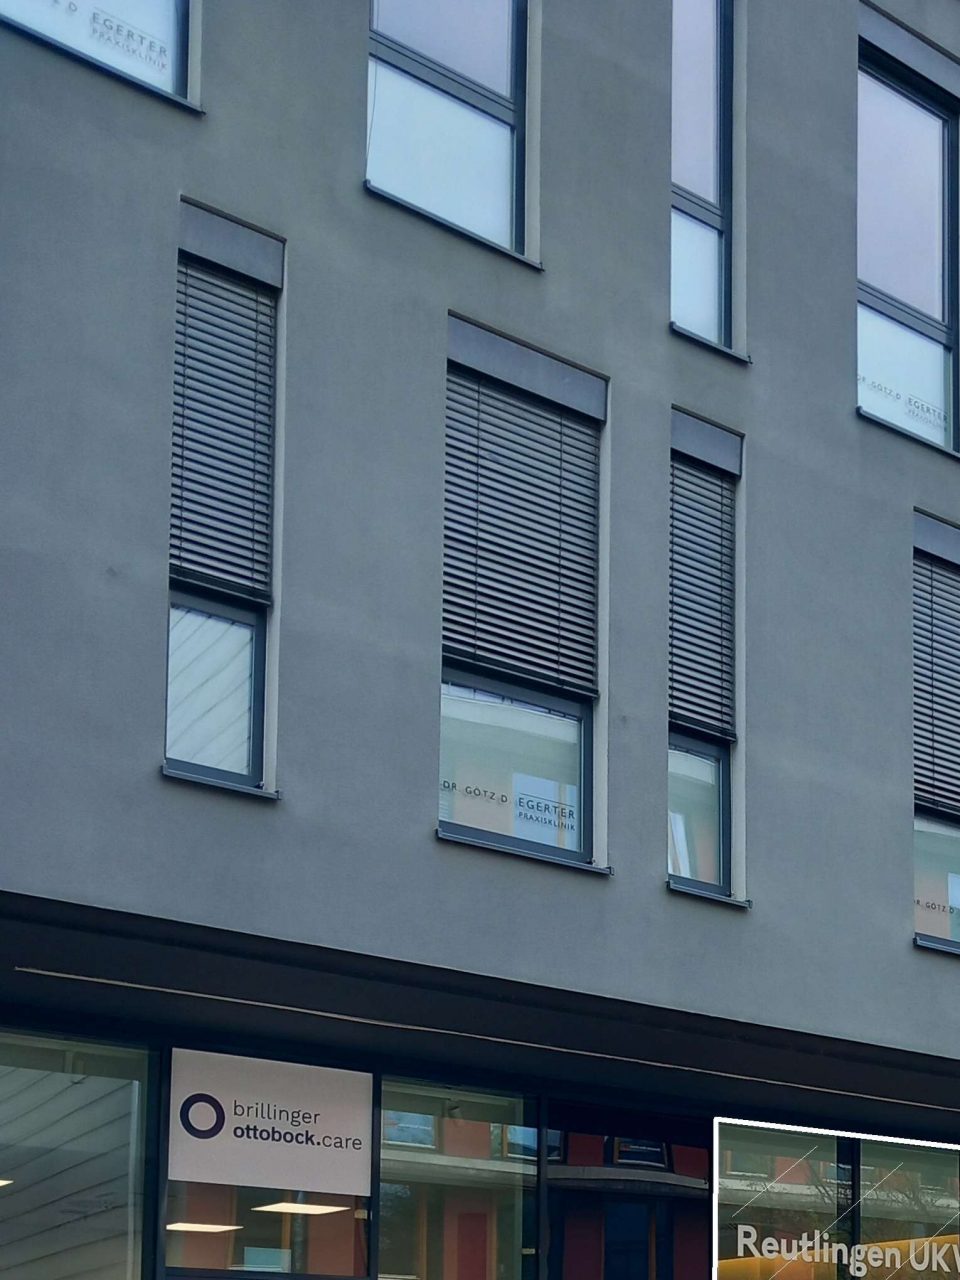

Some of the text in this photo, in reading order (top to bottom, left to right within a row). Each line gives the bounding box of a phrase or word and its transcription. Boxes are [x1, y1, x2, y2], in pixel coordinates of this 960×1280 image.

[91, 12, 168, 57] EGERTER
[518, 797, 575, 820] EGERTER
[518, 811, 576, 831] PRAXISKLINIK
[233, 1099, 321, 1127] brillinger
[233, 1124, 363, 1151] ottobock.care
[736, 1224, 901, 1278] Reutlingen
